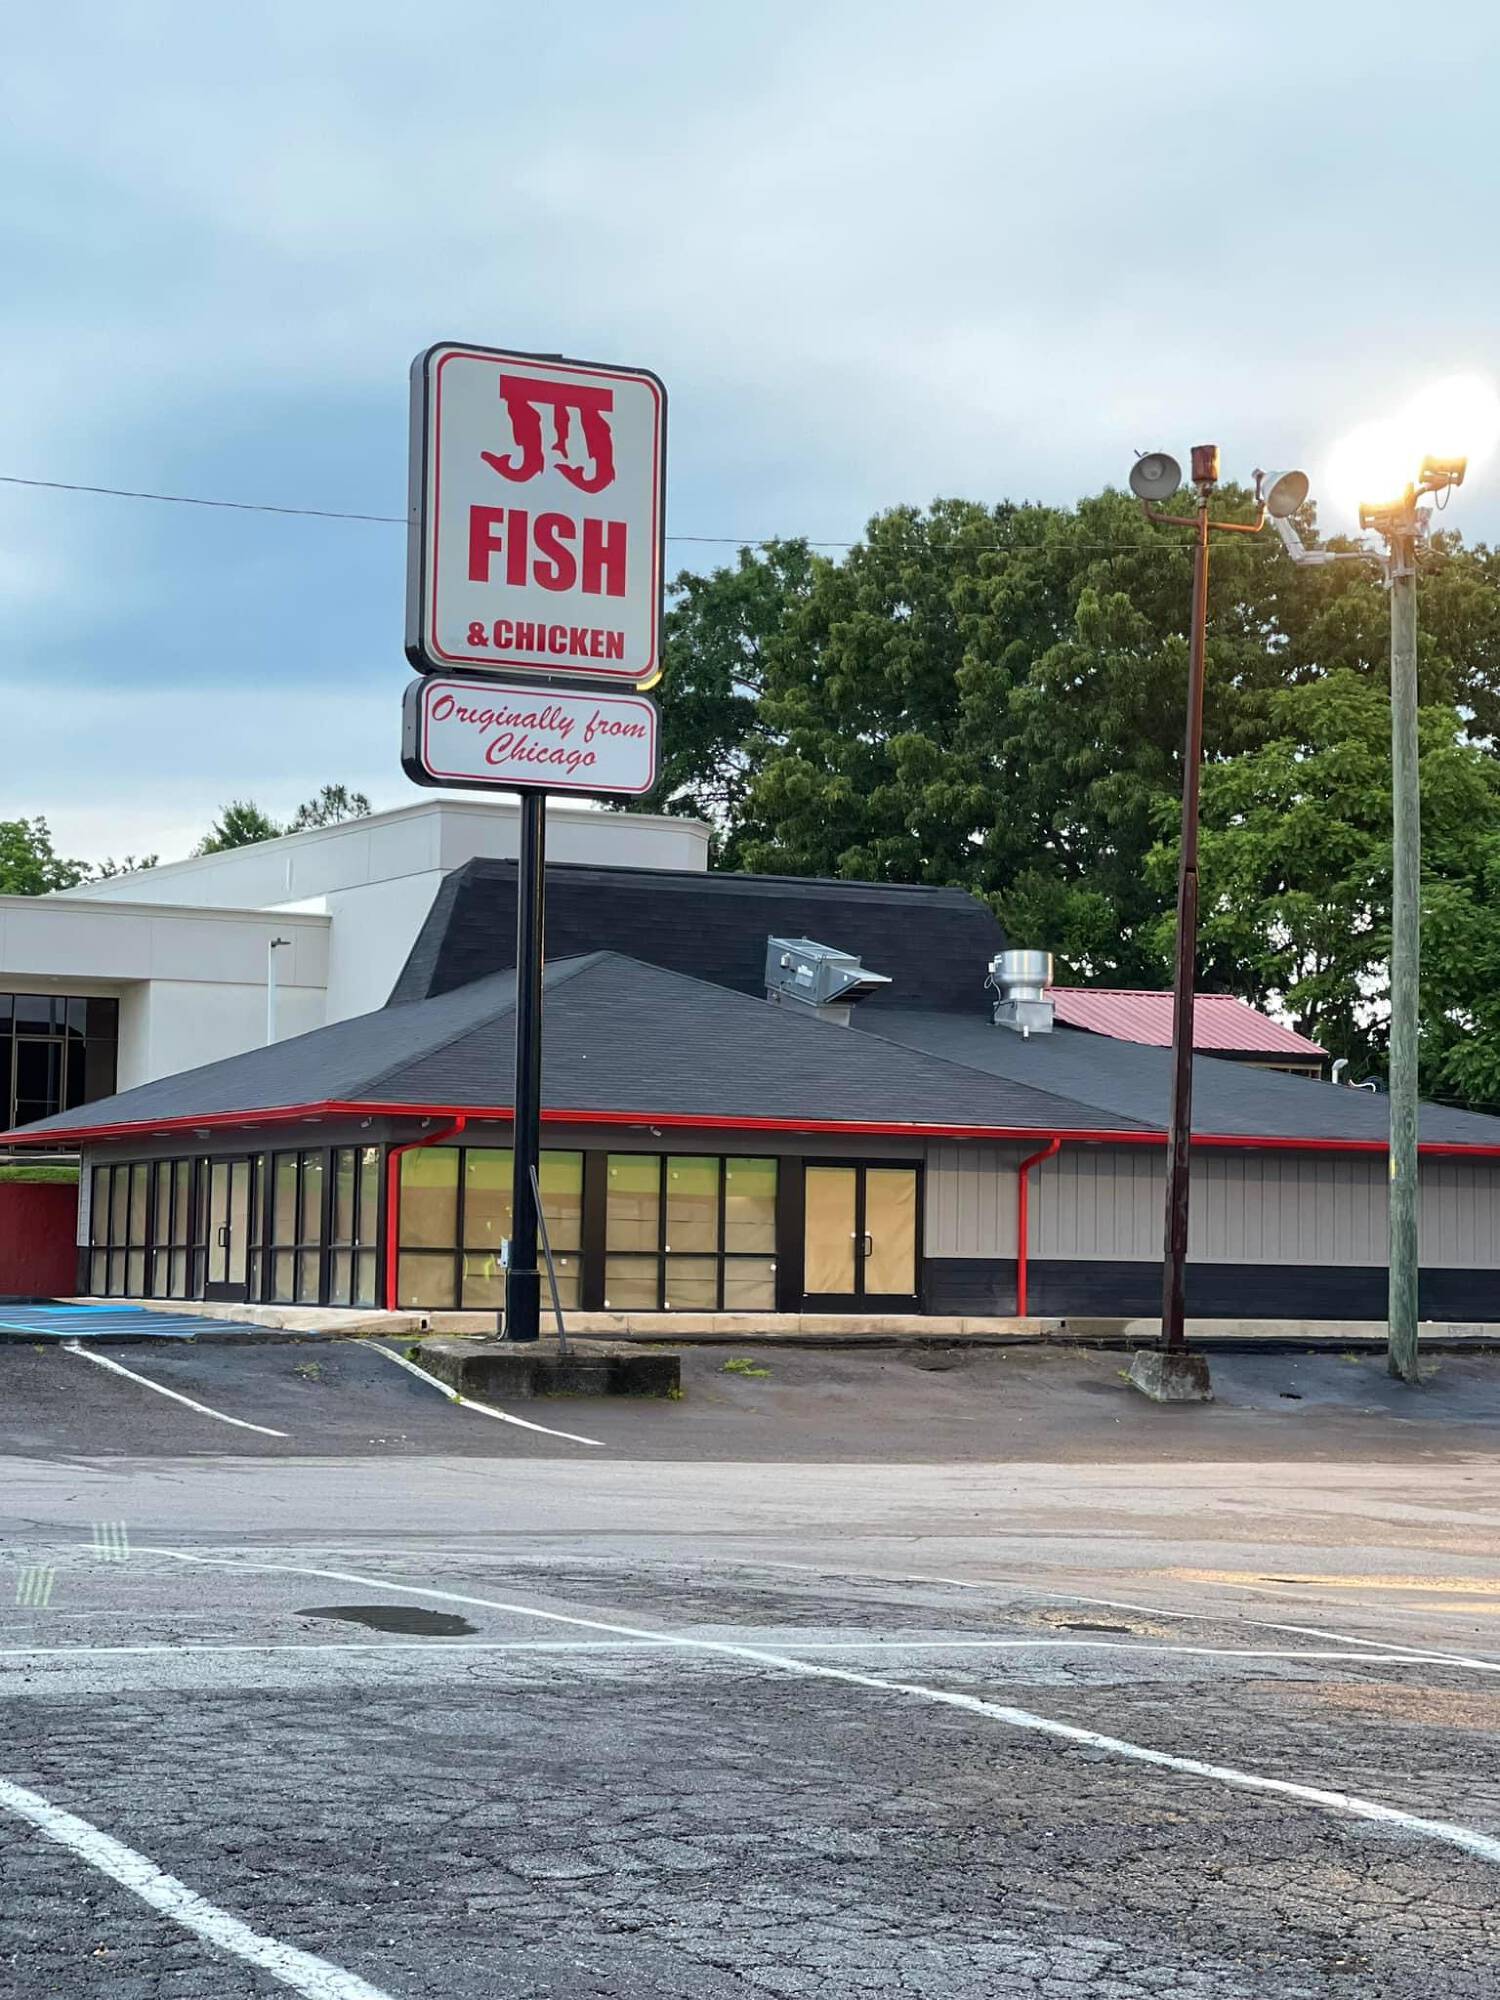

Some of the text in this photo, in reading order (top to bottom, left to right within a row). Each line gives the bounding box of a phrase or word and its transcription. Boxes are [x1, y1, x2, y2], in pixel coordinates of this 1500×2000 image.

[468, 505, 627, 597] FISH
[467, 619, 625, 659] & CHICKEN
[431, 694, 647, 742] Originally from
[484, 732, 598, 776] Chicago
